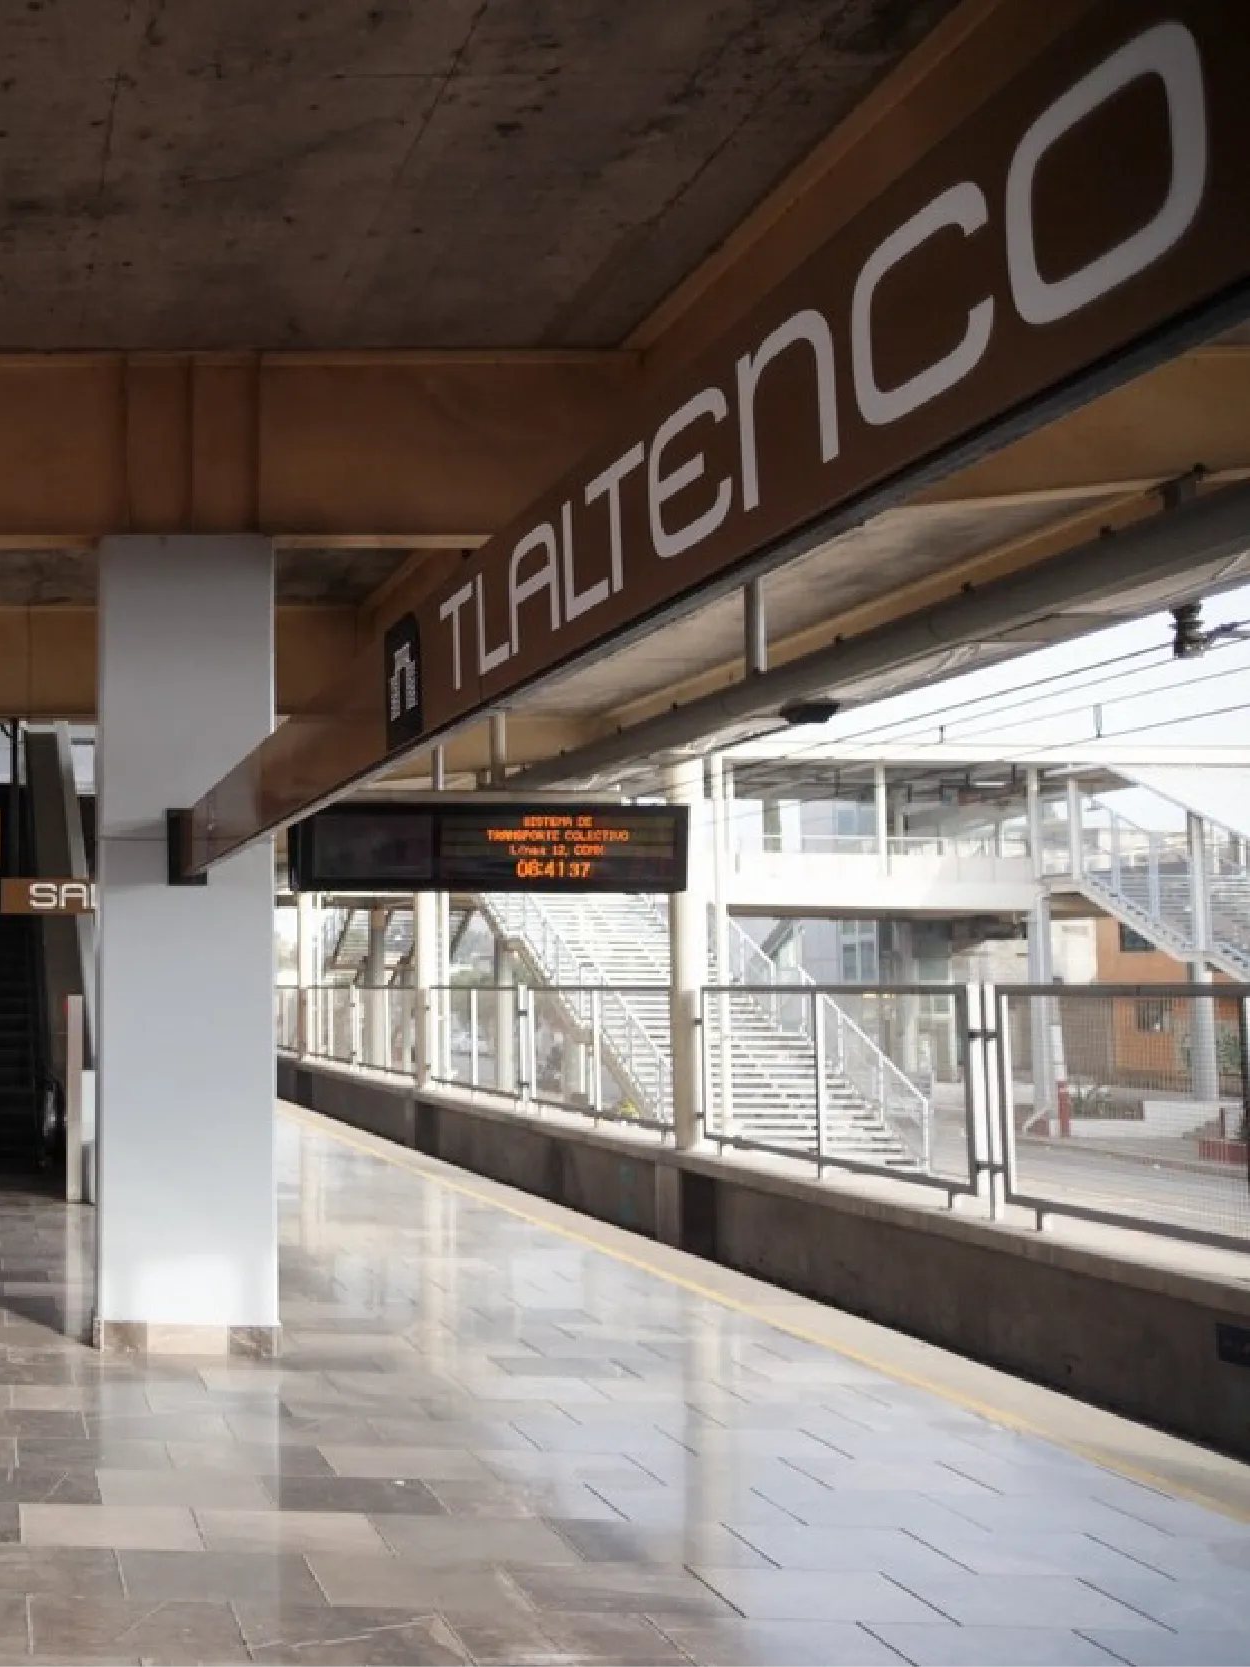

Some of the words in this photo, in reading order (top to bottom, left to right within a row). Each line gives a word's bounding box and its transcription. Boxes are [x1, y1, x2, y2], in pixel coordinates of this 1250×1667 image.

[439, 20, 1208, 690] TLALTENCO
[487, 829, 560, 842] TRANSPORTE
[564, 829, 629, 842] COLECTIVO
